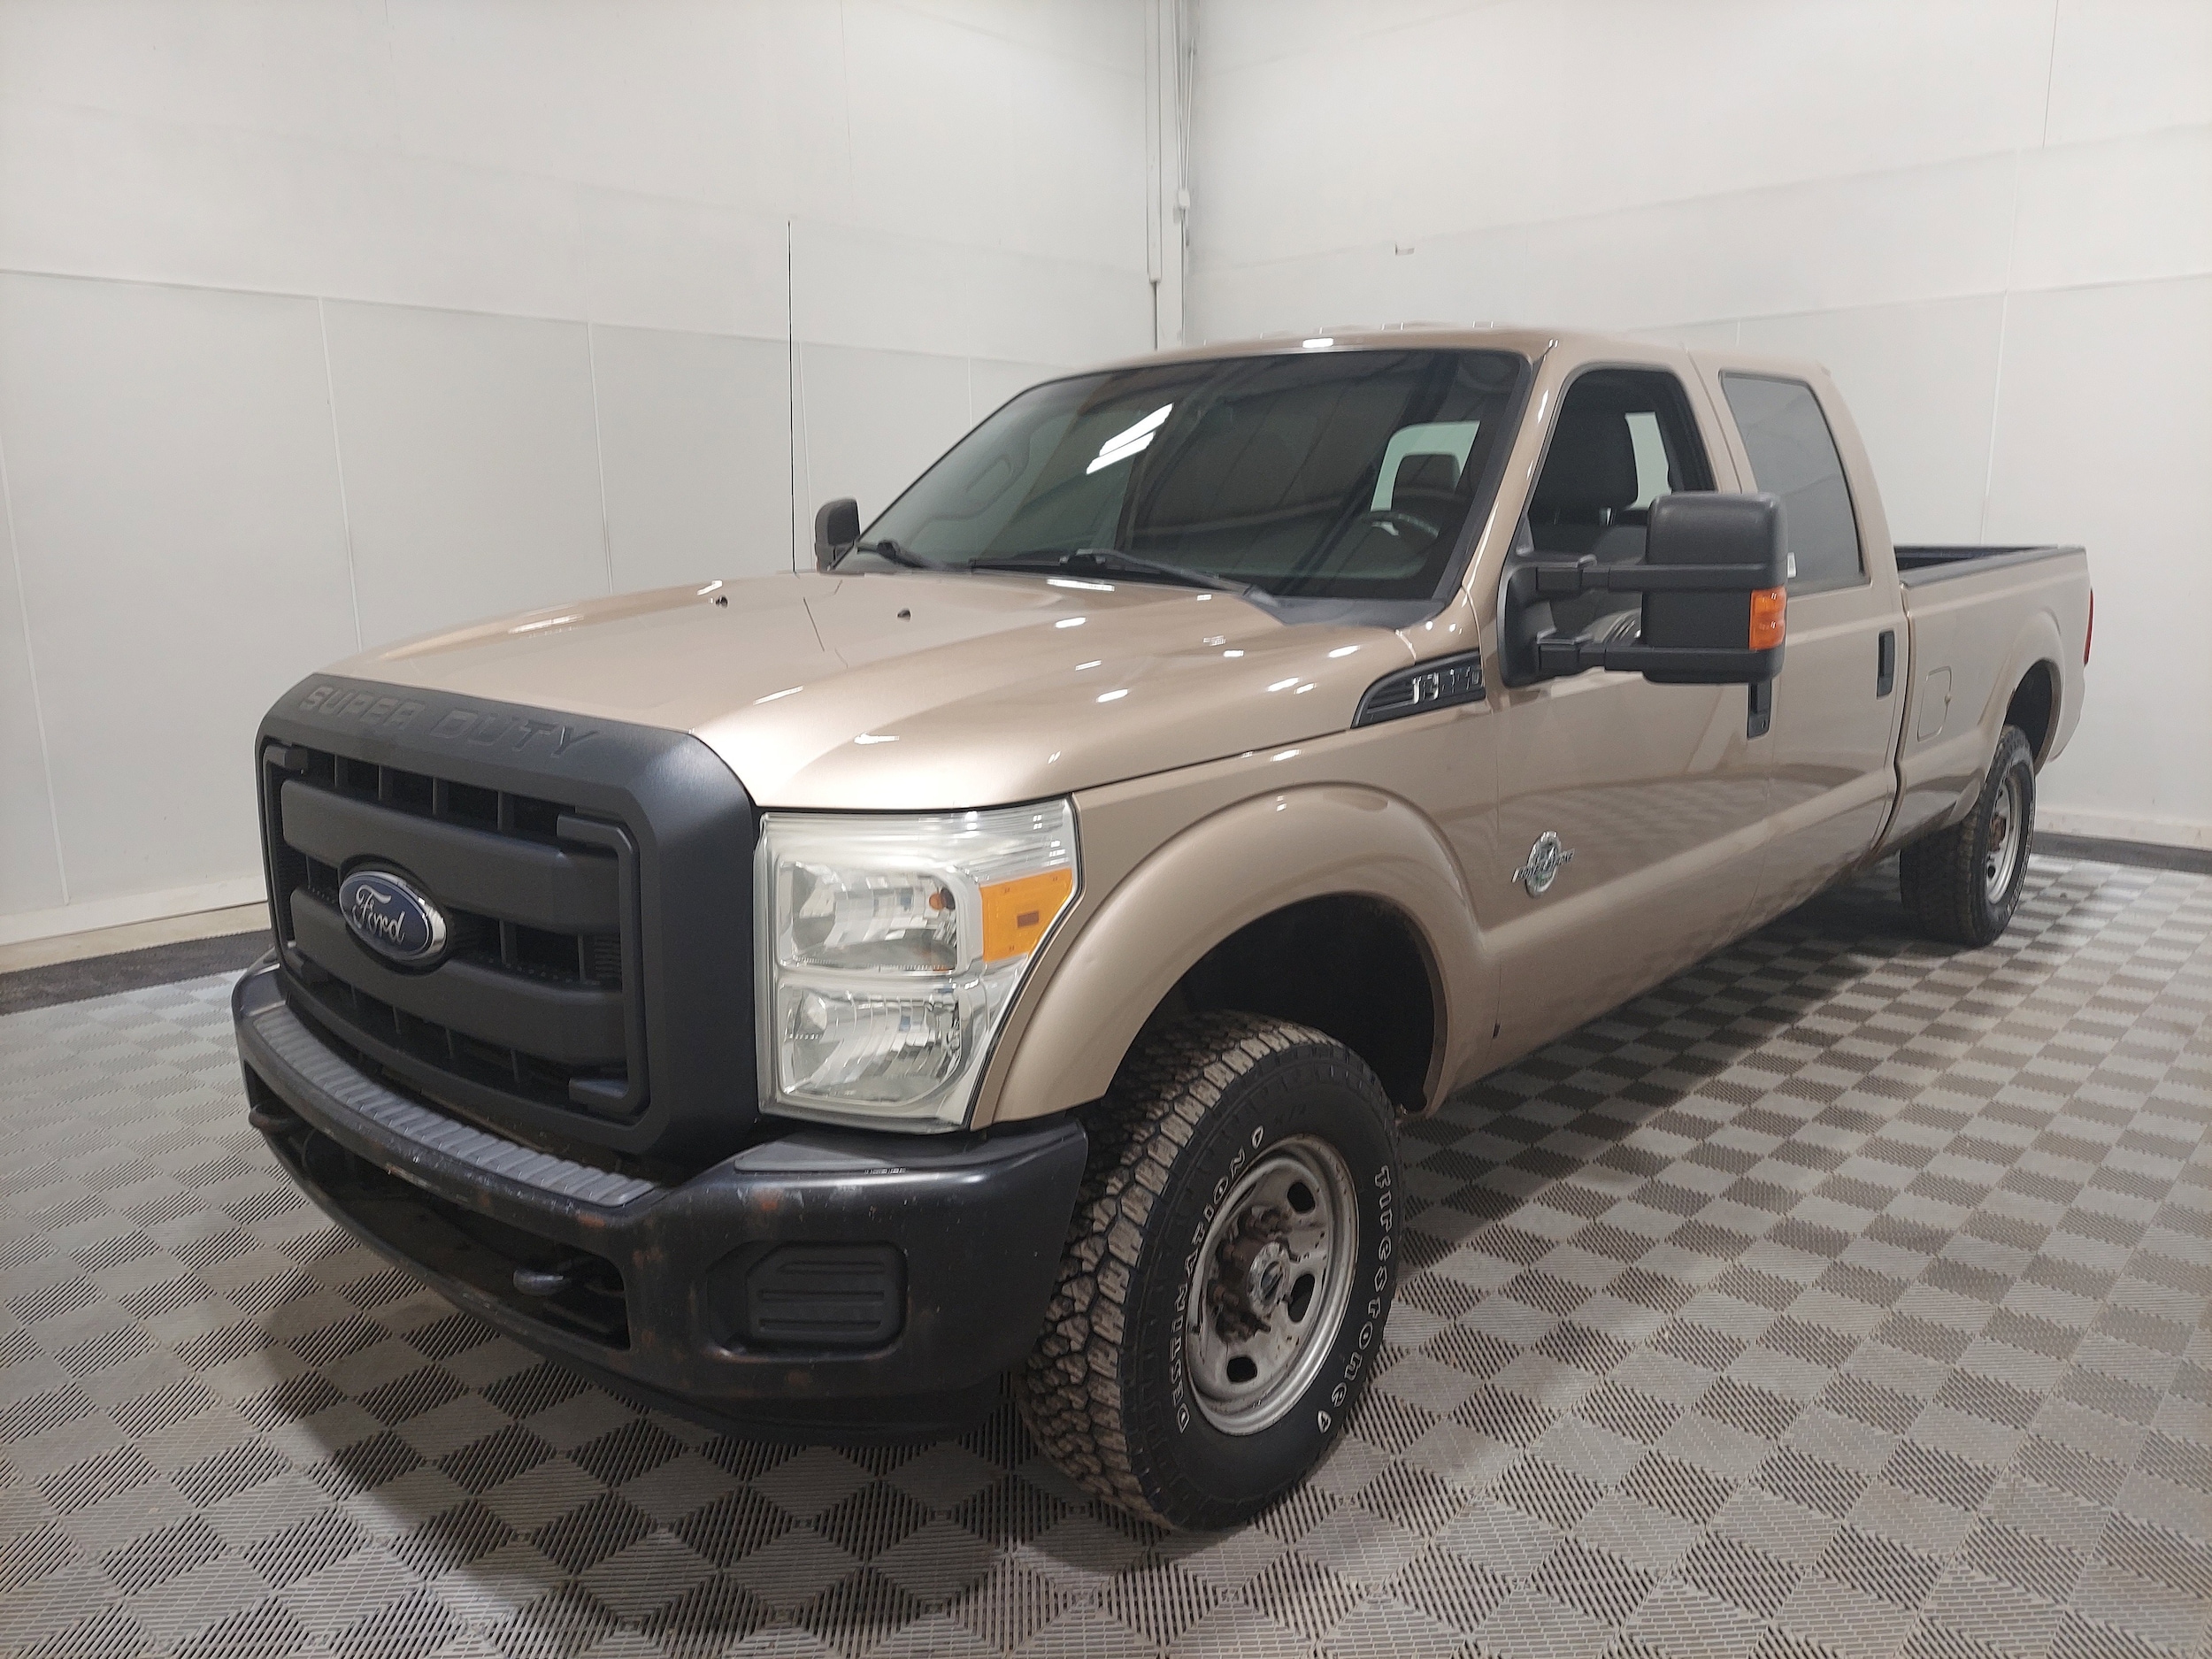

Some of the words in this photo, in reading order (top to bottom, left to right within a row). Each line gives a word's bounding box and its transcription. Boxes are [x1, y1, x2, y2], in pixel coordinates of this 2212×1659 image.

[300, 685, 425, 732] SUPER
[430, 709, 599, 758] DUTY
[351, 884, 406, 946] Ford
[1170, 1147, 1246, 1432] DESTINATION
